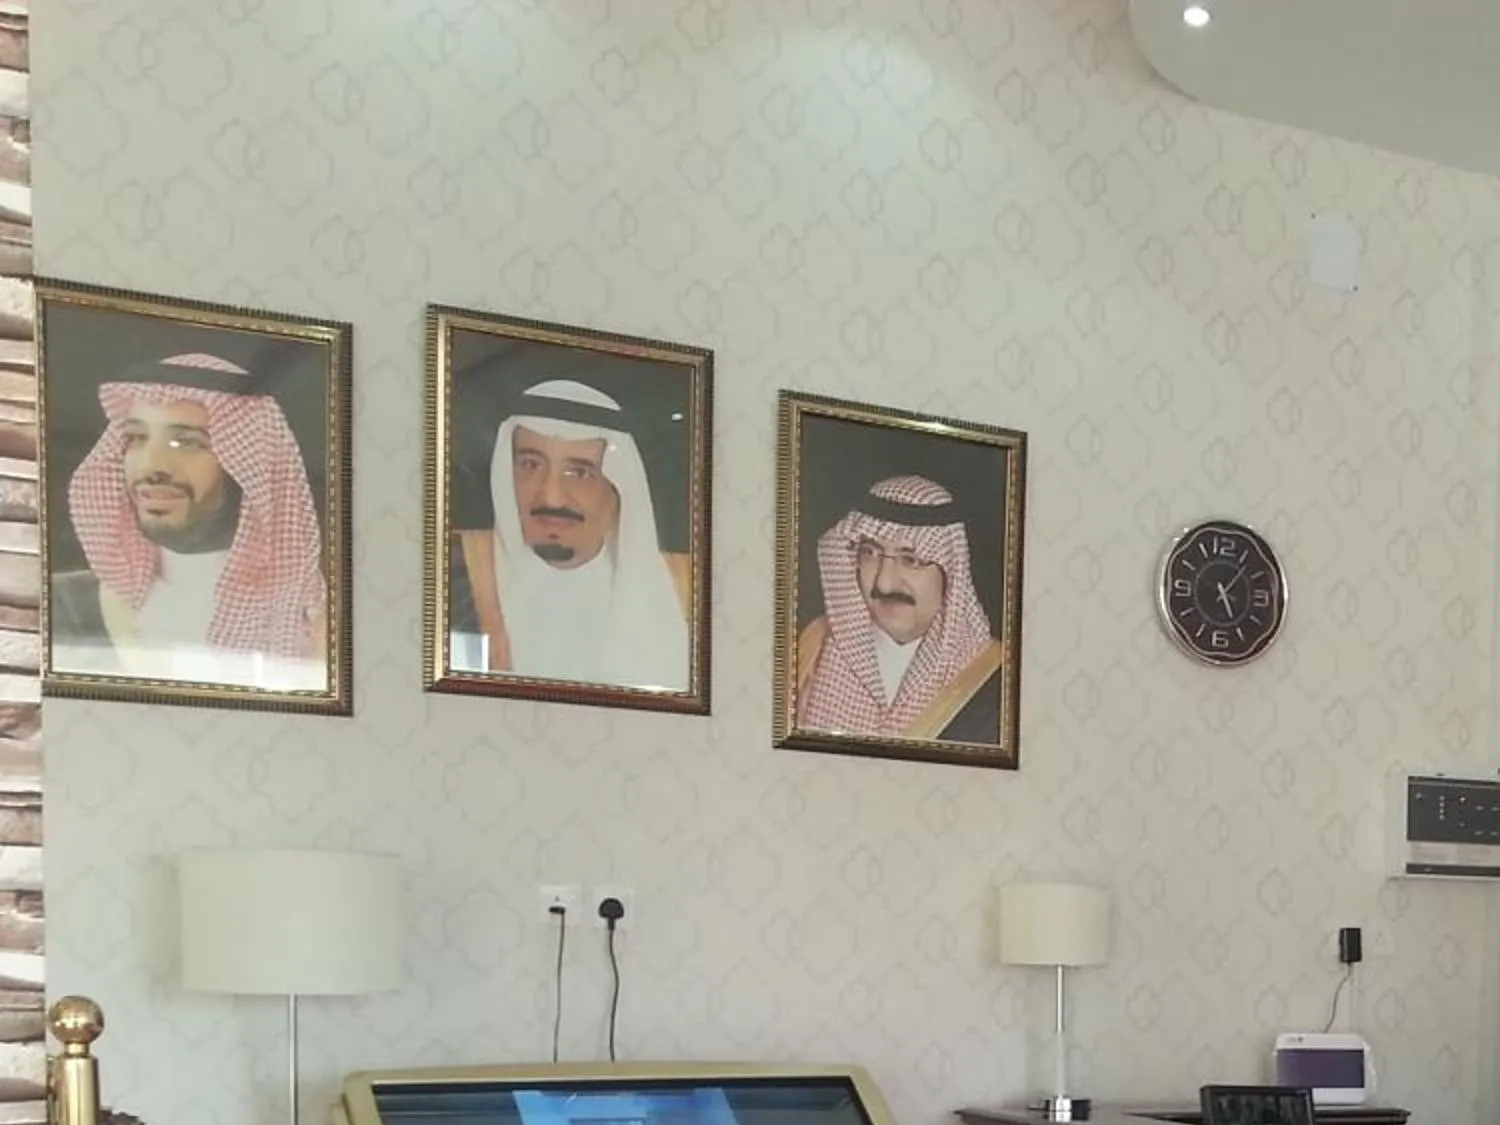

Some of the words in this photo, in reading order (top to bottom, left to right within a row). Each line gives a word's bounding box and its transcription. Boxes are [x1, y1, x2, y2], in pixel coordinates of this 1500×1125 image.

[1213, 536, 1236, 558] 12
[1174, 579, 1192, 597] 9
[1252, 589, 1269, 607] 3
[1211, 631, 1229, 648] 6
